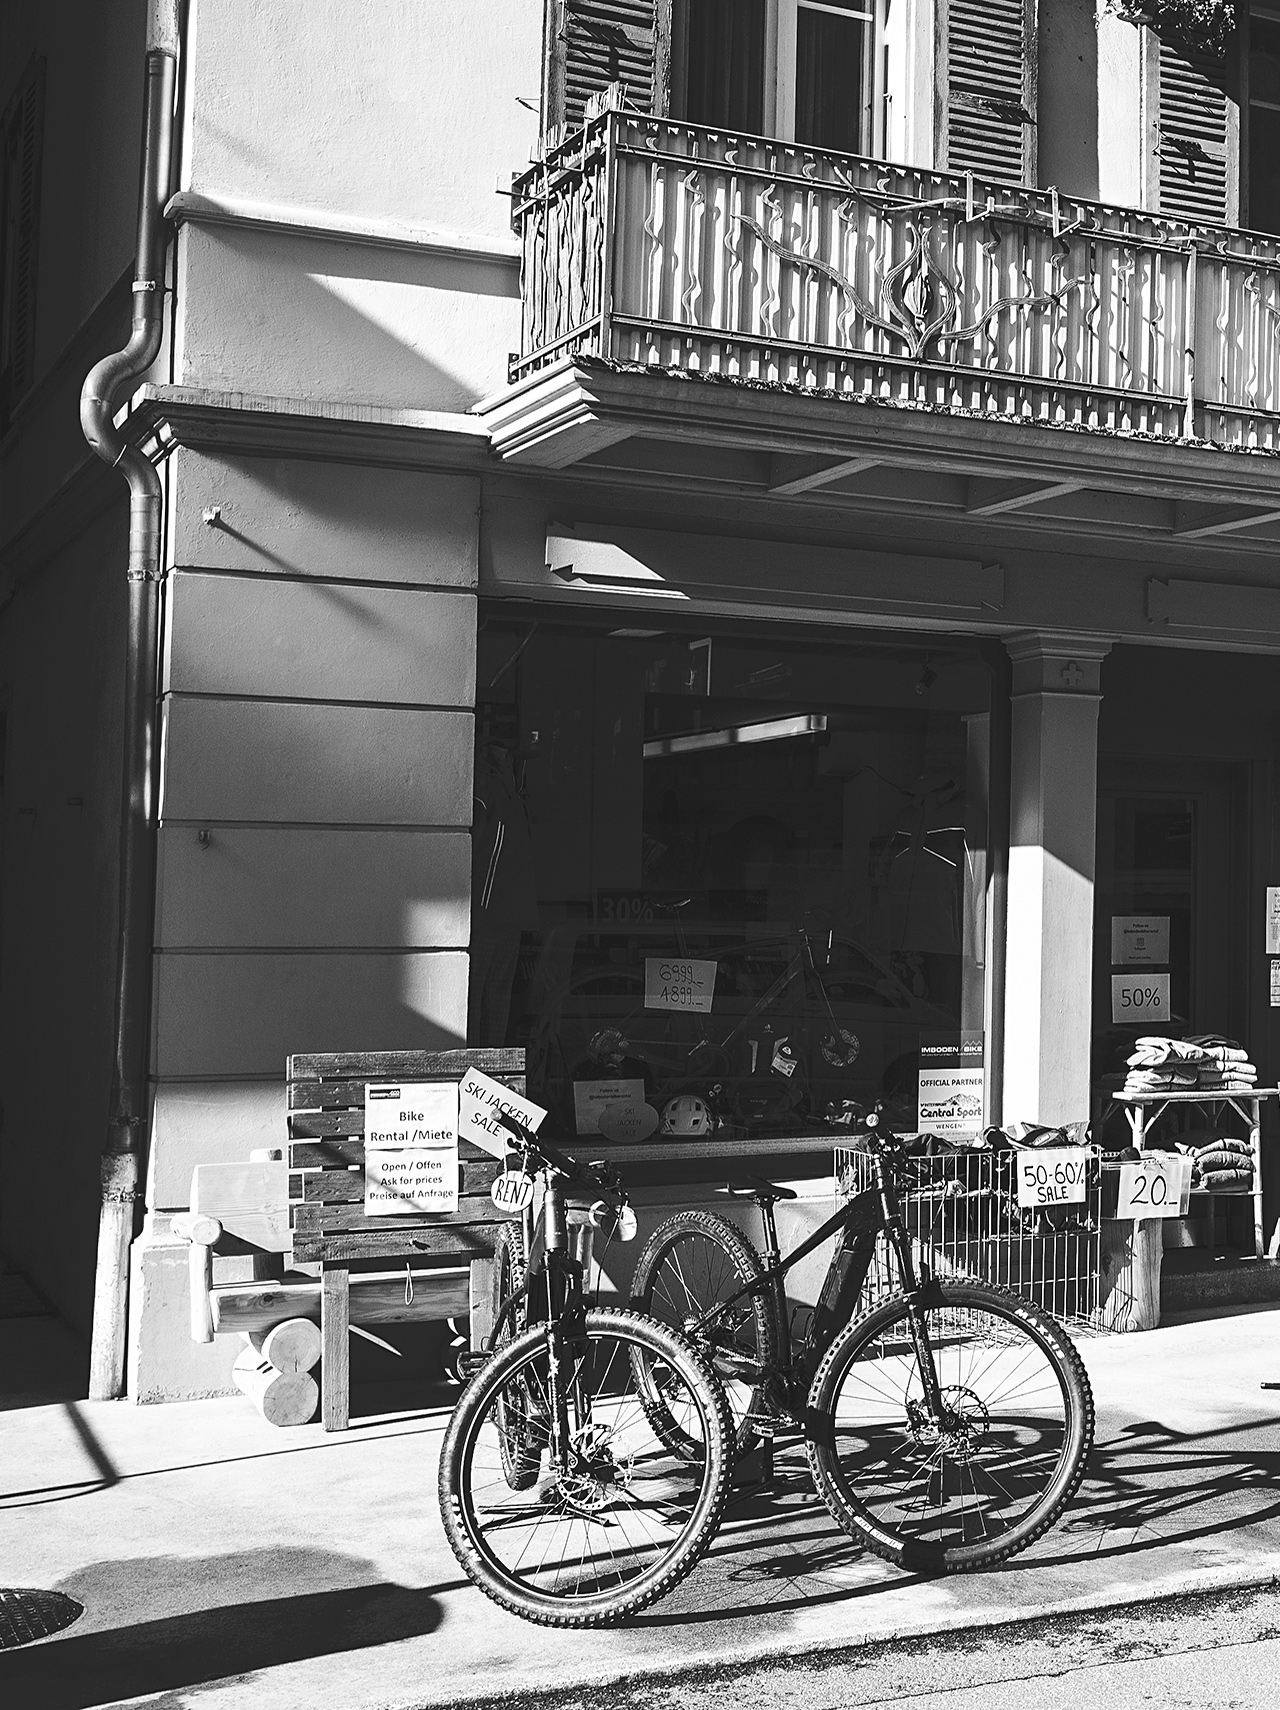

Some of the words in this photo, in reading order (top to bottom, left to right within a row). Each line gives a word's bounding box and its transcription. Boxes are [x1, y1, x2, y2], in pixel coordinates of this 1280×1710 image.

[602, 897, 654, 924] 30%
[1119, 986, 1161, 1008] 50%
[920, 1079, 950, 1087] OFFICIAL
[951, 1078, 983, 1086] PARTNER
[464, 1080, 486, 1102] SKI
[485, 1095, 534, 1130] JACKEN
[919, 1107, 955, 1118] Central
[956, 1106, 982, 1119] Sport
[399, 1111, 425, 1122] Bike
[616, 1119, 642, 1127] JACKEN
[470, 1111, 501, 1138] SALE
[370, 1131, 408, 1142] Rental
[411, 1129, 453, 1142] /Miete
[381, 1162, 407, 1173] Open
[416, 1160, 442, 1171] Offen
[380, 1176, 396, 1186] Ask
[398, 1176, 413, 1186] for
[415, 1175, 443, 1187] prices
[1024, 1161, 1085, 1188] 50-60%
[369, 1191, 397, 1201] Preise
[399, 1190, 415, 1200] auf
[417, 1188, 454, 1200] Anfrage
[495, 1178, 532, 1209] RENT
[1037, 1185, 1069, 1202] SALE
[1014, 1308, 1065, 1359] MAXXIS
